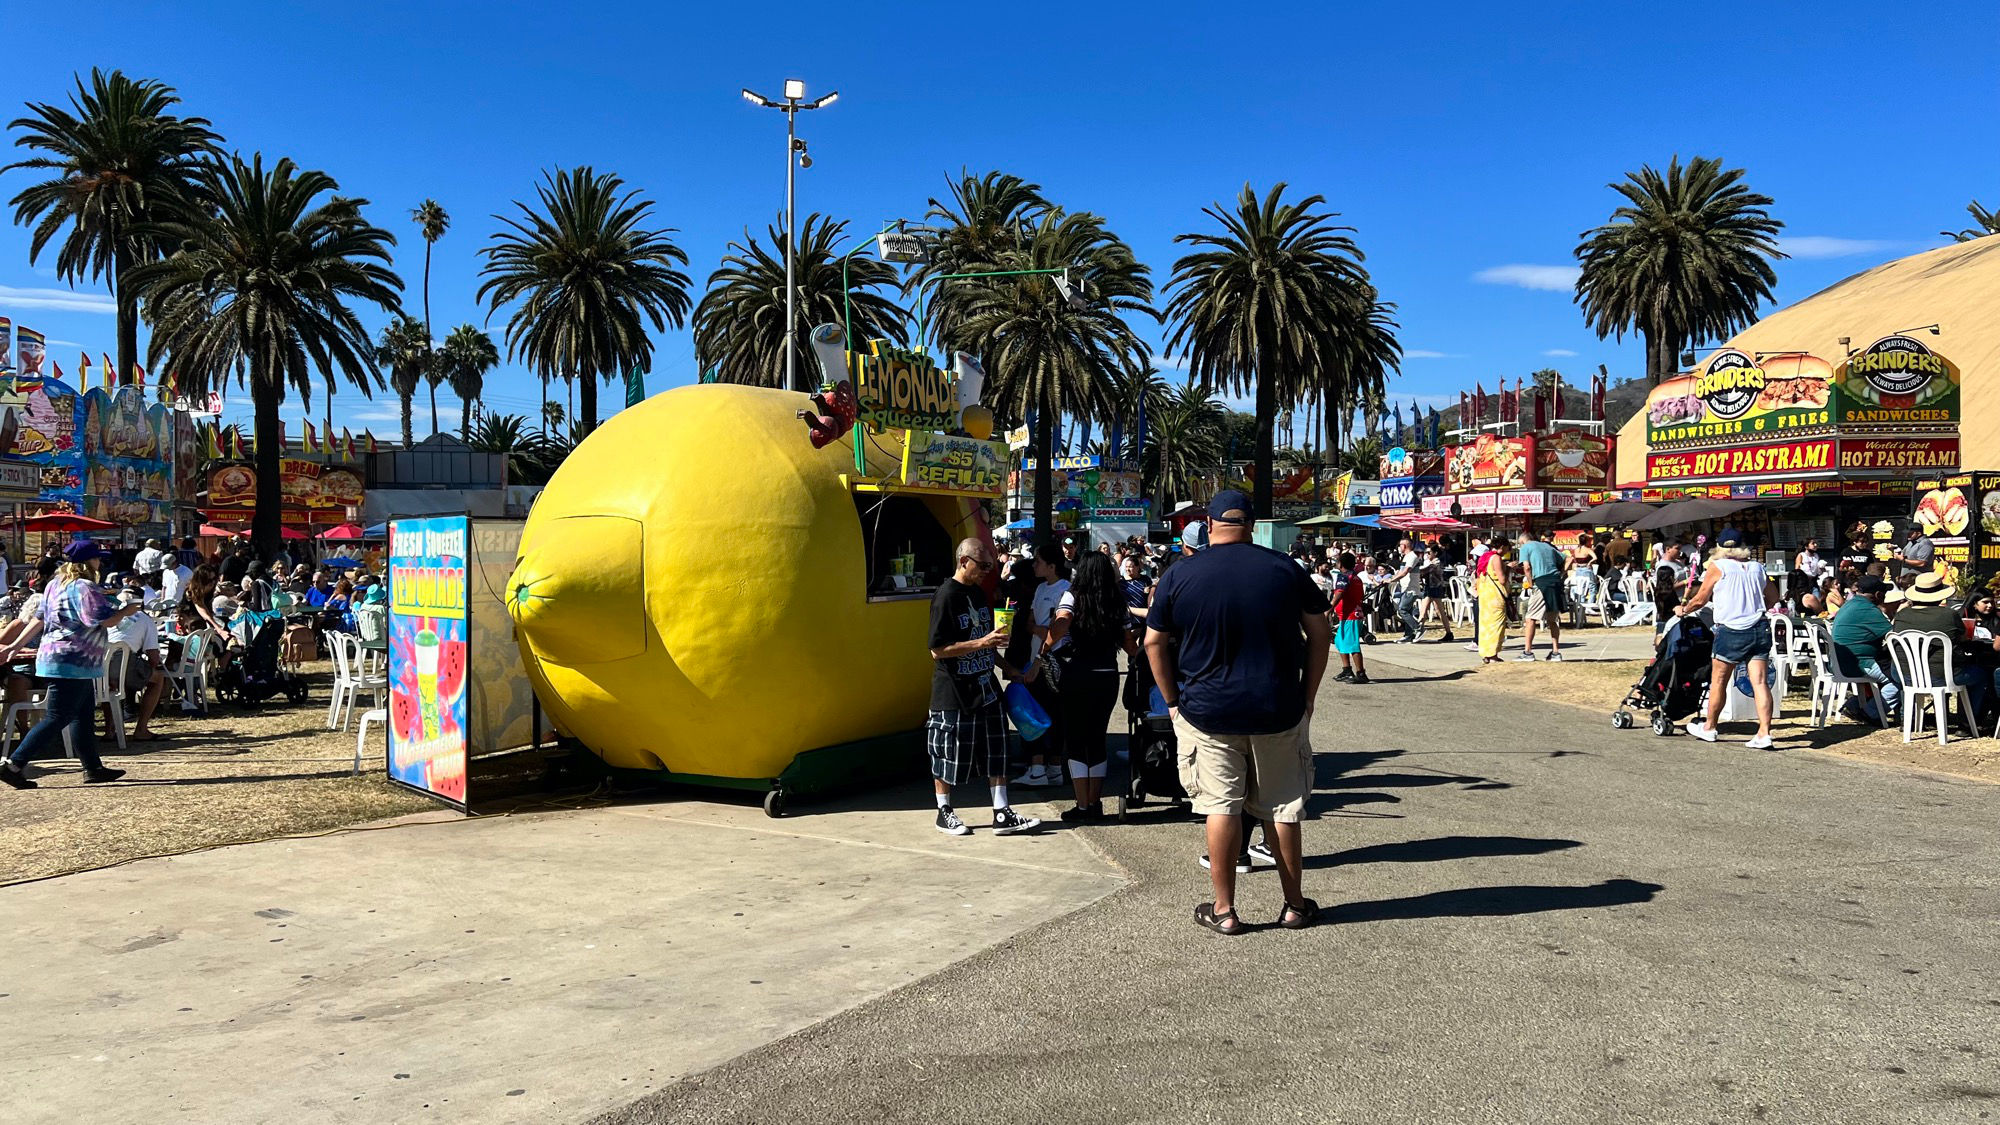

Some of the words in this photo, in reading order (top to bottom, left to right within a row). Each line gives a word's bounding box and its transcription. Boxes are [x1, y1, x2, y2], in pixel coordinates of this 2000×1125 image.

[881, 339, 935, 370] Fresh
[1853, 352, 1942, 374] GRINDERS
[856, 352, 960, 413] LEMONADE
[1695, 366, 1765, 398] GRINDERS
[1895, 374, 1923, 390] DELICIOUS
[859, 396, 960, 434] Squeezed
[1846, 410, 1950, 421] SANDWICHES
[1651, 422, 1742, 442] SANDWICHES
[1754, 419, 1765, 430] &
[1778, 411, 1829, 428] FRIES
[1865, 441, 1905, 449] World's
[949, 451, 973, 467] $5
[1060, 457, 1091, 468] TACO
[1103, 458, 1120, 468] FISH
[1122, 460, 1139, 471] TACO
[1694, 452, 1729, 475] HOT
[1731, 443, 1830, 473] PASTRAMI
[1841, 451, 1874, 466] HOT
[1876, 450, 1957, 466] PASTRAMI
[285, 461, 319, 477] BREAD
[917, 465, 1000, 487] REFILLS
[1651, 465, 1691, 478] BEST
[1381, 484, 1413, 505] GYROS
[1784, 482, 1803, 495] FRIES
[1096, 508, 1143, 517] SOUVENIRS
[393, 531, 423, 557] FRESH
[425, 528, 464, 559] SQUEEZED
[392, 564, 465, 620] LEMONADE
